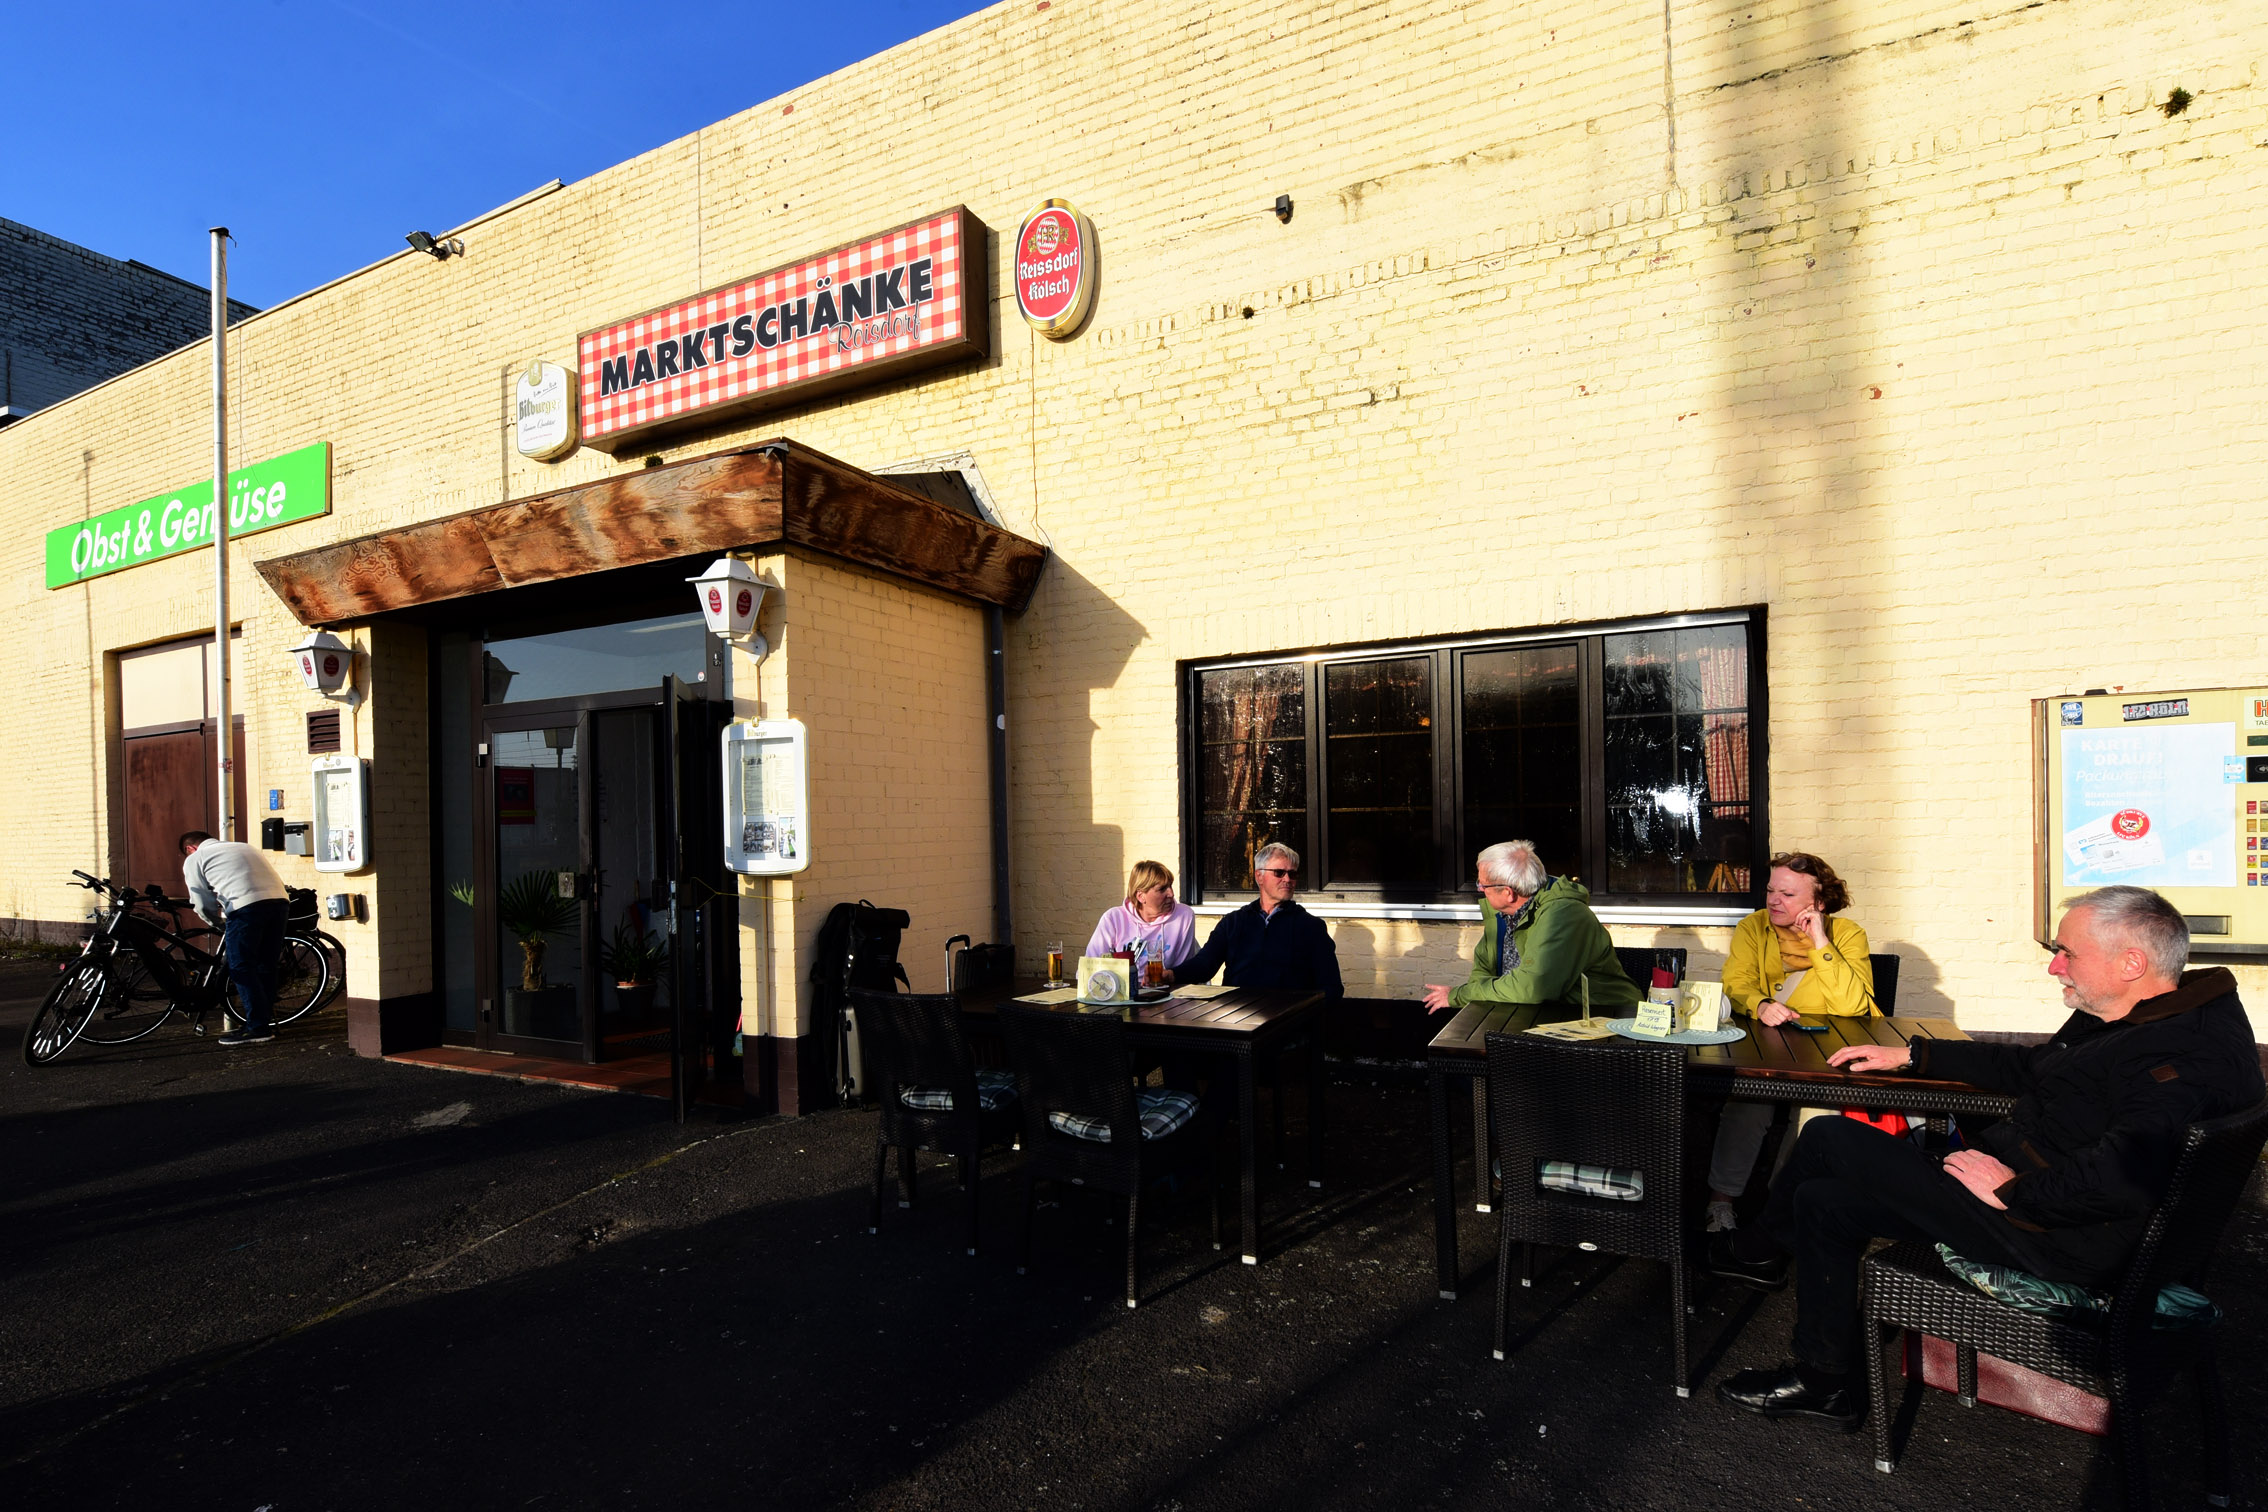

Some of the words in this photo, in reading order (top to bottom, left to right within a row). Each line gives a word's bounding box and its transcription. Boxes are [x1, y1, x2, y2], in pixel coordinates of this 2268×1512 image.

[1019, 246, 1079, 280] Reissdorf
[1028, 274, 1070, 301] Kölsch
[600, 255, 934, 397] MARKTSCHÄNKE
[827, 298, 921, 354] Roisdorf
[518, 398, 561, 421] Bitburger
[71, 520, 131, 573] Obst
[133, 509, 154, 555] &
[2081, 739, 2143, 752] KARTE
